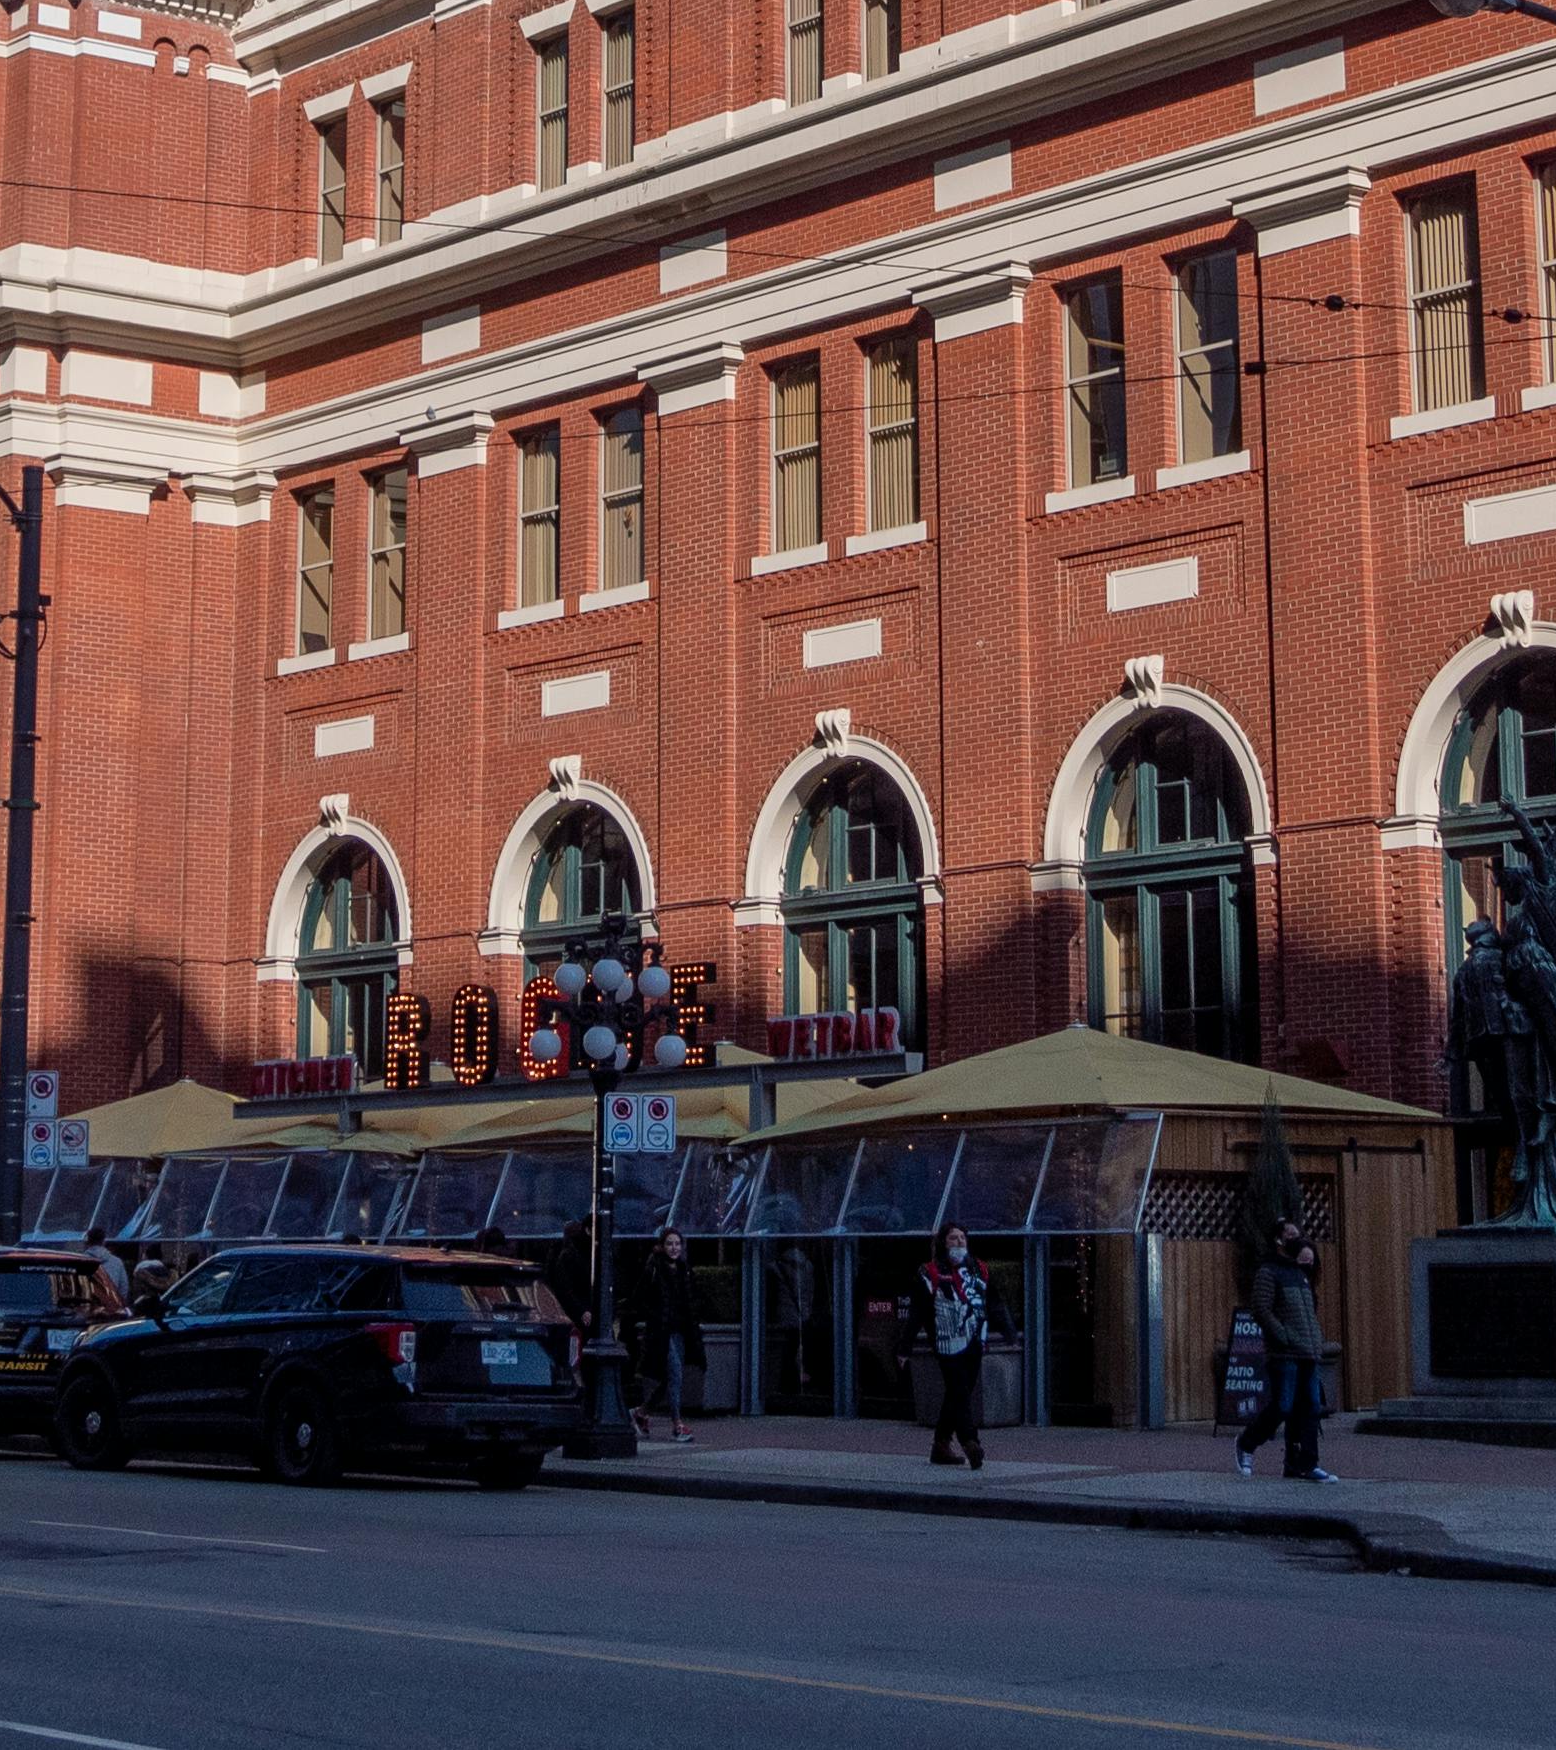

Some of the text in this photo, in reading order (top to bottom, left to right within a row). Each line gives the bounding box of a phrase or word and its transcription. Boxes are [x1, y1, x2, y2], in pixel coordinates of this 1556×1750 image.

[384, 962, 717, 1089] ROGE
[1226, 1365, 1255, 1378] PATIO
[1224, 1379, 1265, 1392] SEATING
